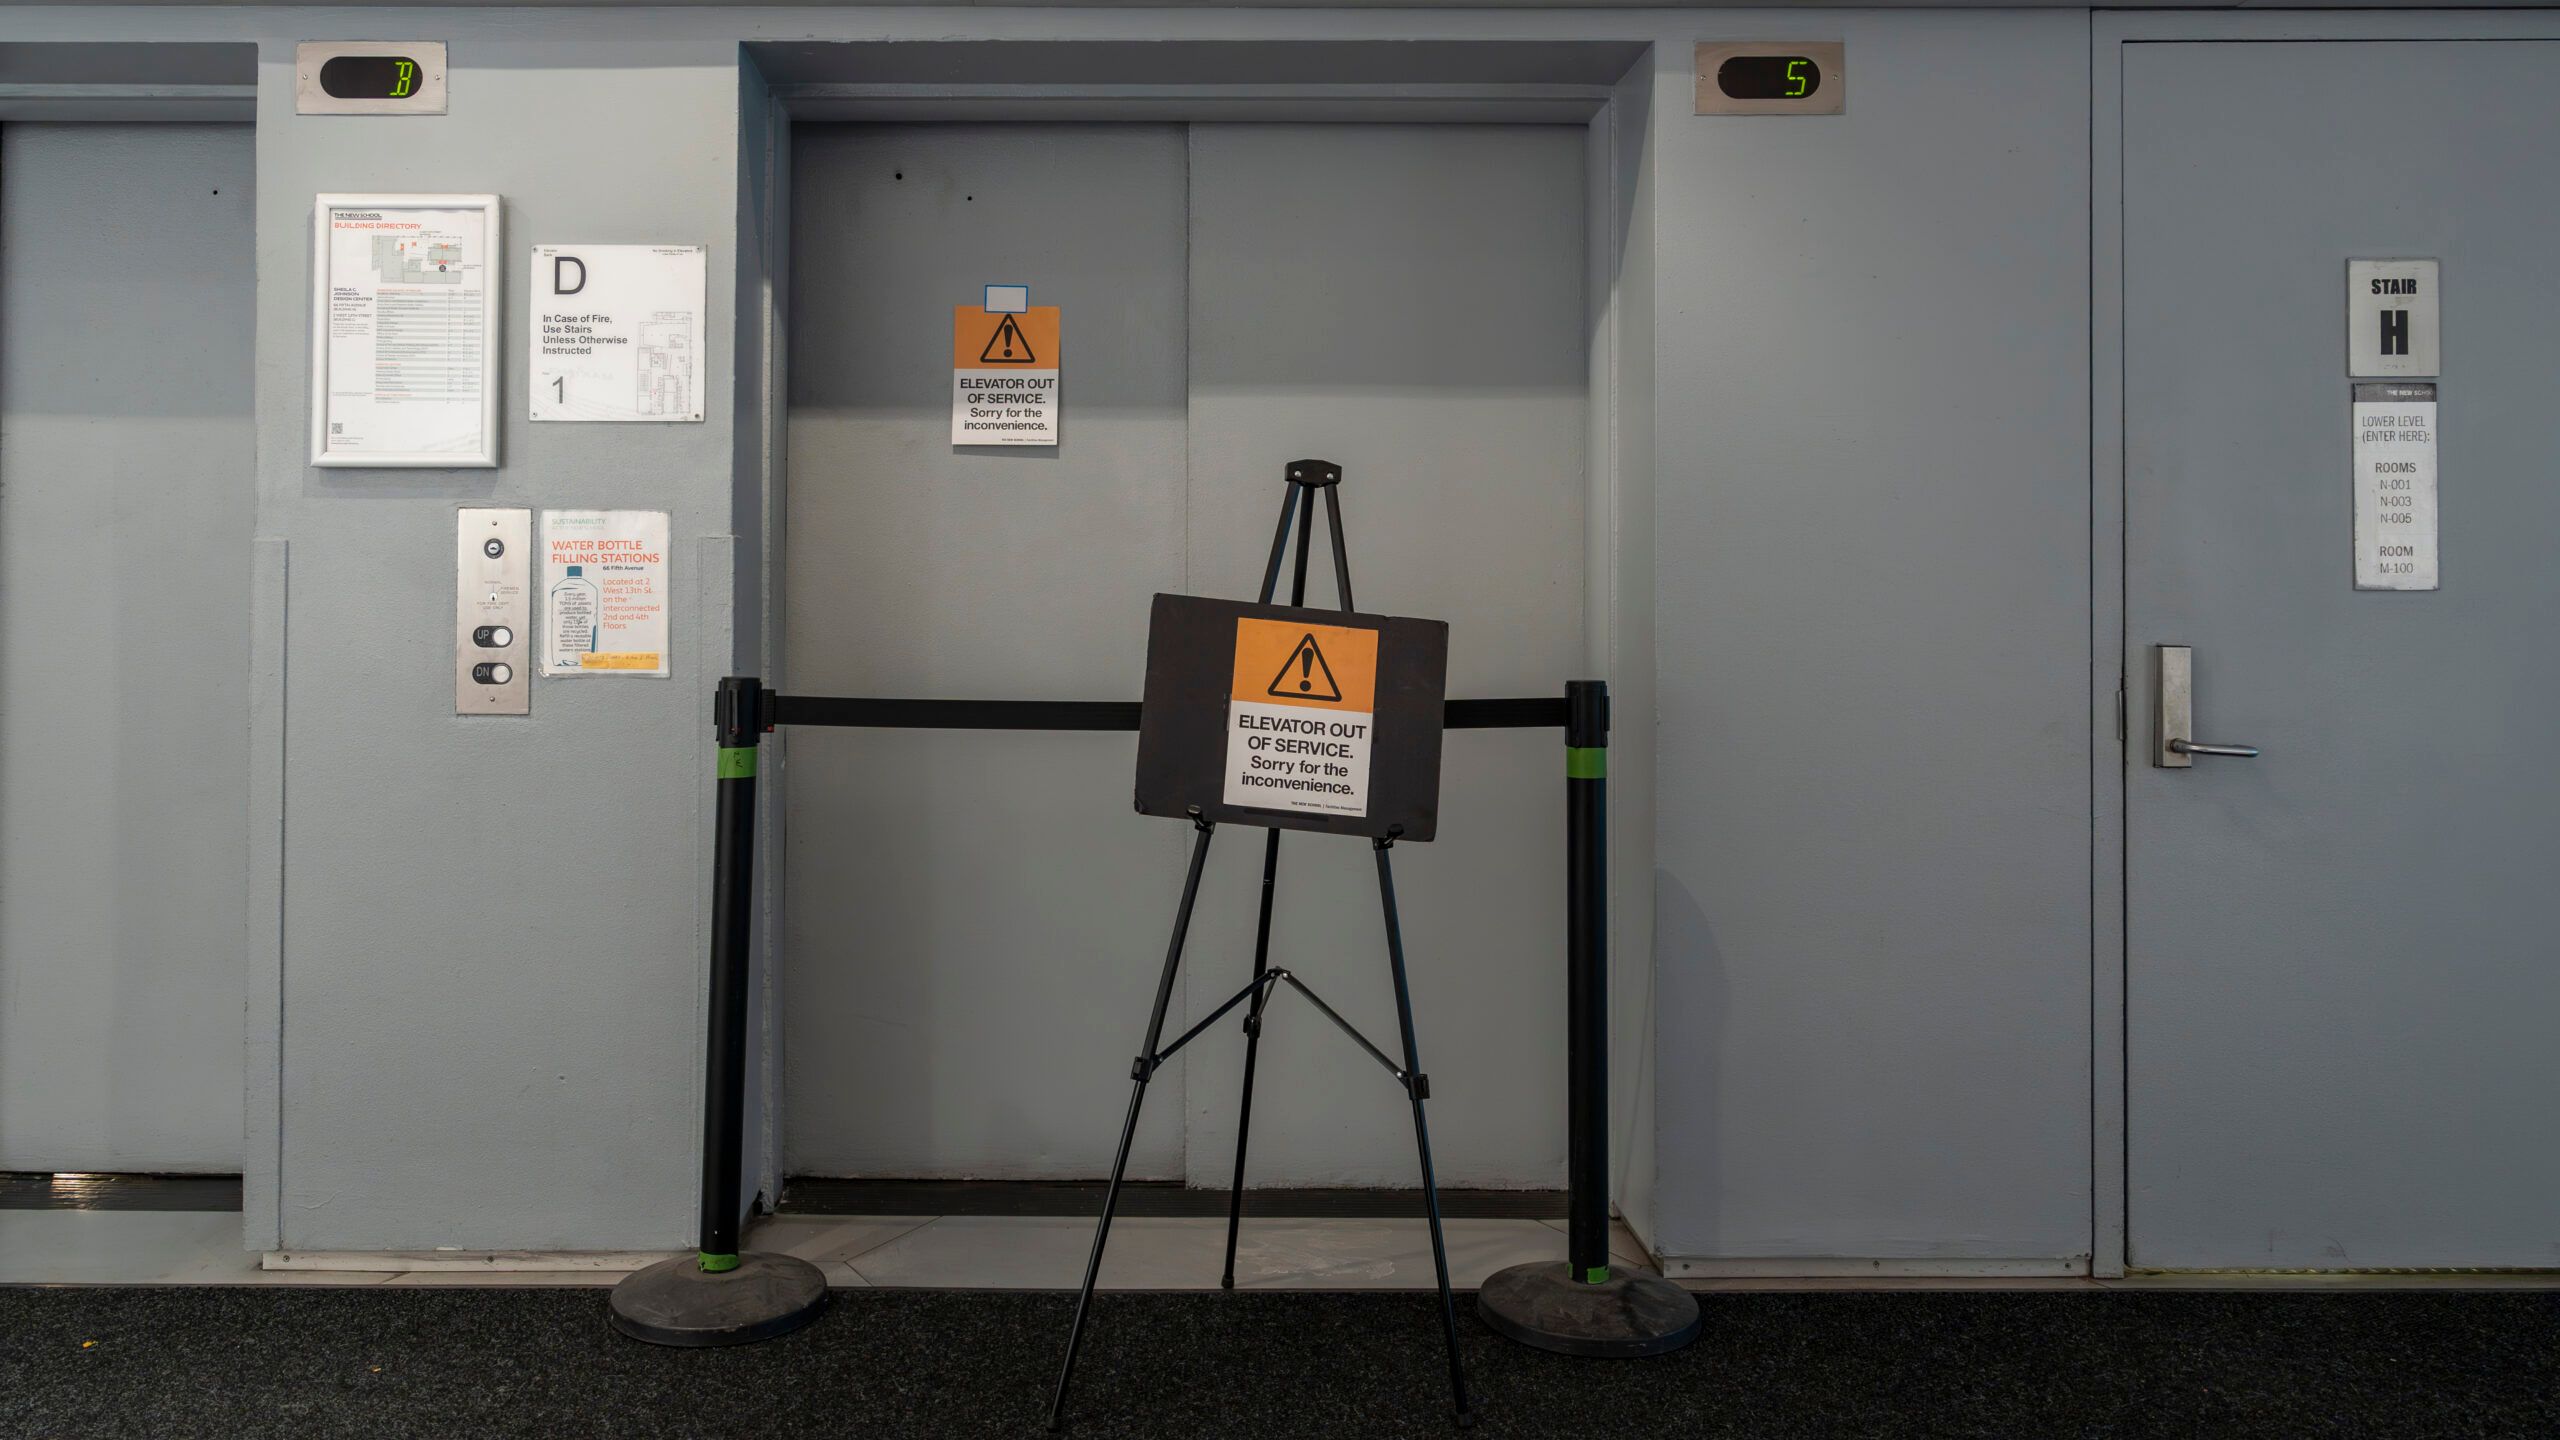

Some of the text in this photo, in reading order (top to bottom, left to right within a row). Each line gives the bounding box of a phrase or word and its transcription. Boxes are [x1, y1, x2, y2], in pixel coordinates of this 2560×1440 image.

[554, 256, 587, 295] D
[2371, 278, 2417, 295] STAIR
[543, 314, 613, 324] In Case of Fire,
[543, 325, 593, 334] Use Stairs
[2380, 309, 2409, 355] H
[543, 335, 628, 345] Unless Otherwise
[542, 345, 592, 355] Instructed
[960, 378, 1055, 389] ELEVATOR OUT
[552, 376, 564, 404] 1
[967, 393, 1046, 404] OF SERVICE.
[970, 407, 1042, 420] Sorry for the
[964, 420, 1048, 431] inconvenience.
[2362, 415, 2426, 427] LOWER LEVEL
[2362, 430, 2431, 443] (ENTER HERE):
[2375, 462, 2416, 473] ROOMS
[2380, 479, 2411, 490] N-001
[2380, 496, 2412, 507] N-003
[2380, 513, 2412, 524] N-005
[552, 540, 643, 551] WATER BOTTLE
[2379, 546, 2413, 557] ROOM
[552, 553, 660, 564] FILLING STATIONS
[2380, 562, 2413, 574] M-100
[603, 578, 633, 586] Located
[646, 578, 650, 586] 2
[603, 586, 623, 595] West
[625, 586, 642, 595] 13th
[603, 604, 660, 612] interconnected
[603, 613, 649, 621] 2nd and 4th
[603, 622, 627, 630] Floors
[477, 629, 490, 640] UP
[476, 666, 490, 677] DN
[1238, 714, 1367, 739] ELEVATOR OUT
[1247, 735, 1354, 759] OF SERVICE.
[1250, 755, 1349, 777] Sorry for the
[1241, 771, 1355, 796] inconvenience.
